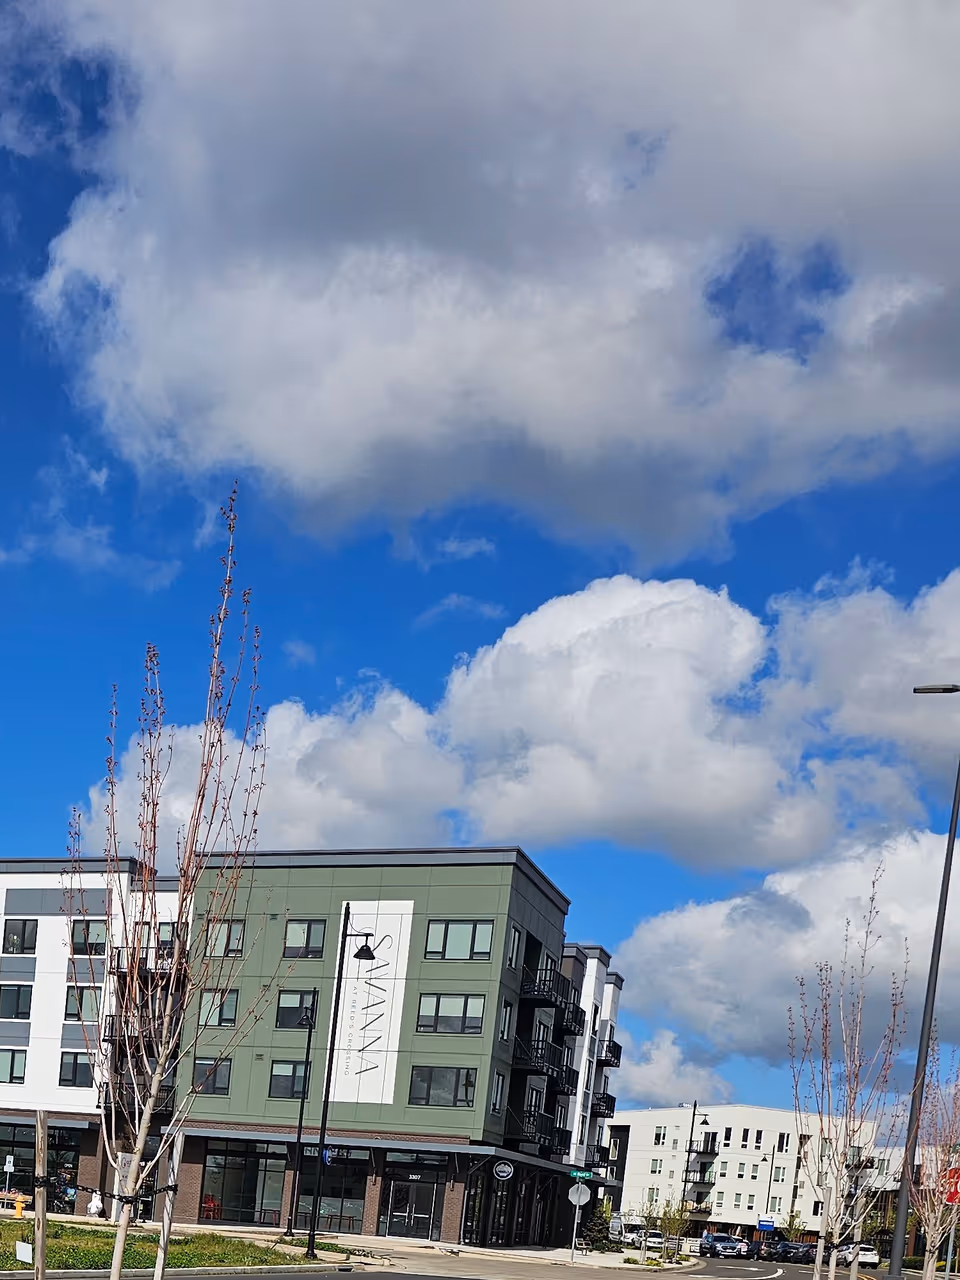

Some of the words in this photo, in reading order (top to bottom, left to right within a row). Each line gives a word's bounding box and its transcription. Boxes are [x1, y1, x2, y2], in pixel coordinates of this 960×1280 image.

[352, 986, 358, 995] AT
[355, 927, 393, 1075] SAVANNA
[348, 999, 357, 1029] REED'S
[344, 1033, 354, 1076] CROSSING
